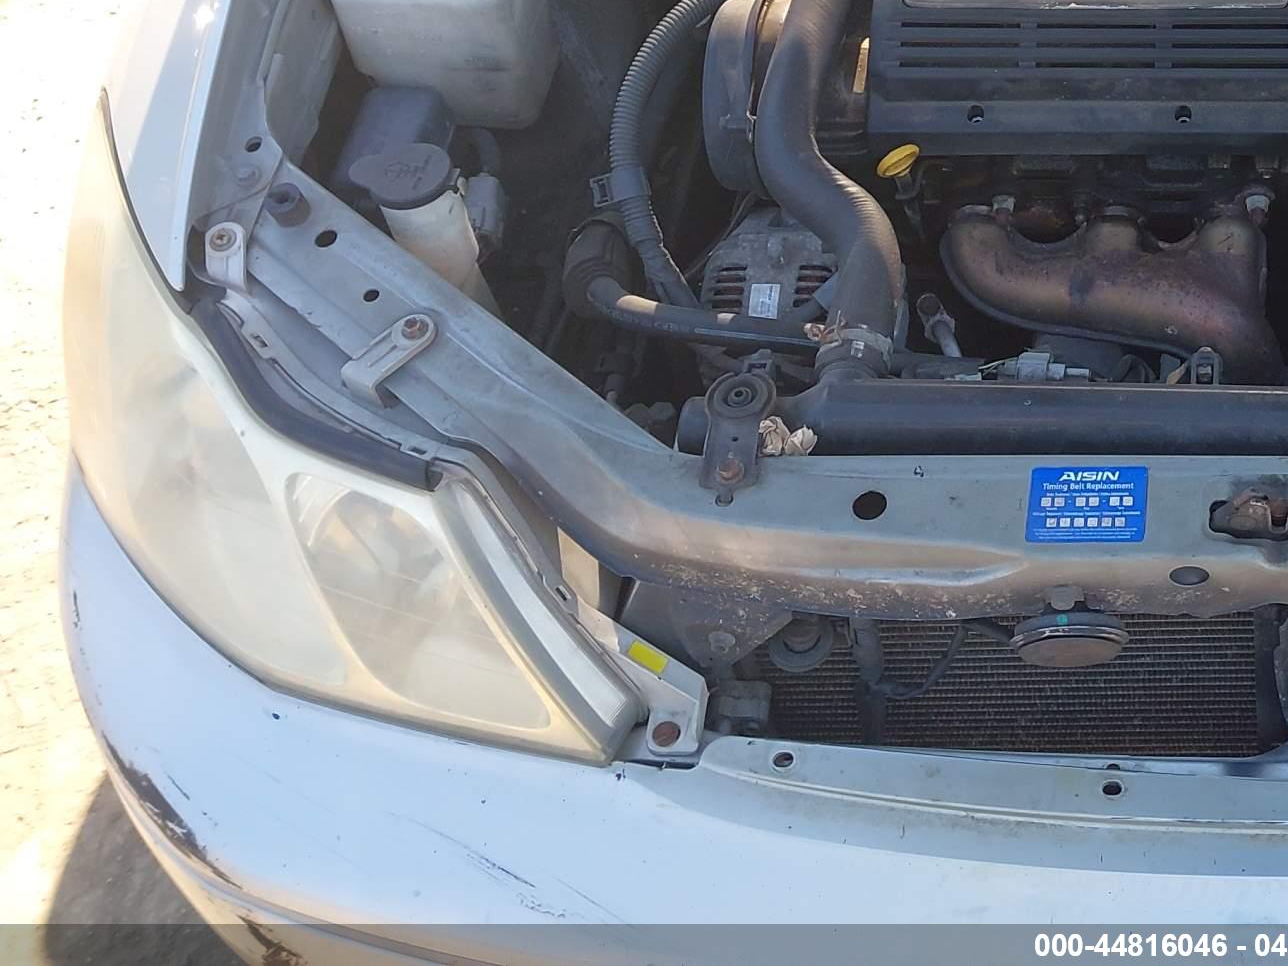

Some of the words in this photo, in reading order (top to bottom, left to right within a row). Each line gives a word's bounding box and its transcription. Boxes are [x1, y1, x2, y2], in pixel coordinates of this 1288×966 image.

[1059, 471, 1120, 482] AISIN
[1043, 482, 1068, 492] Timing
[1070, 482, 1085, 490] Belt
[1086, 482, 1134, 492] Replacement
